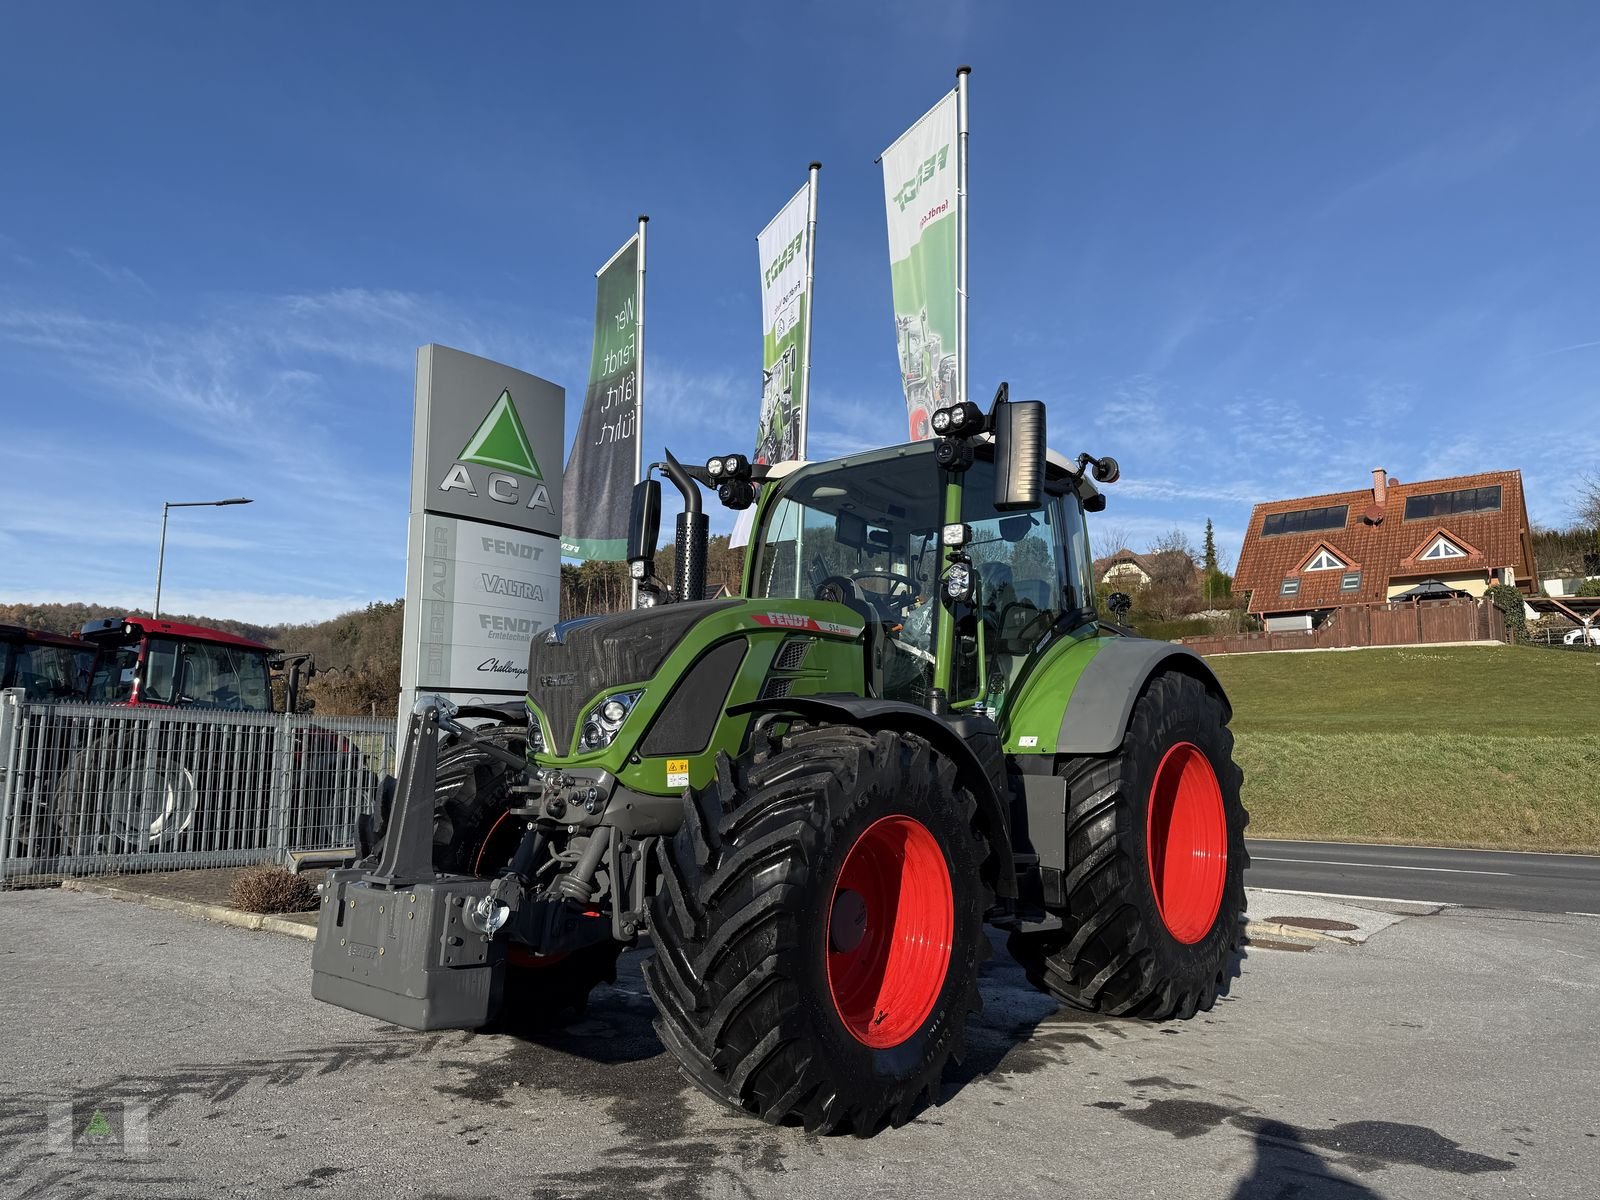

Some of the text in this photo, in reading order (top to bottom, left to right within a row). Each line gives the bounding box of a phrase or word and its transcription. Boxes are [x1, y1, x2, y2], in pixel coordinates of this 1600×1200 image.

[438, 463, 555, 515] ACA
[481, 537, 544, 560] FENDT
[481, 573, 544, 602] VALTRA
[479, 614, 542, 634] FENDT
[767, 612, 810, 627] FENDT
[477, 657, 529, 679] Challenge
